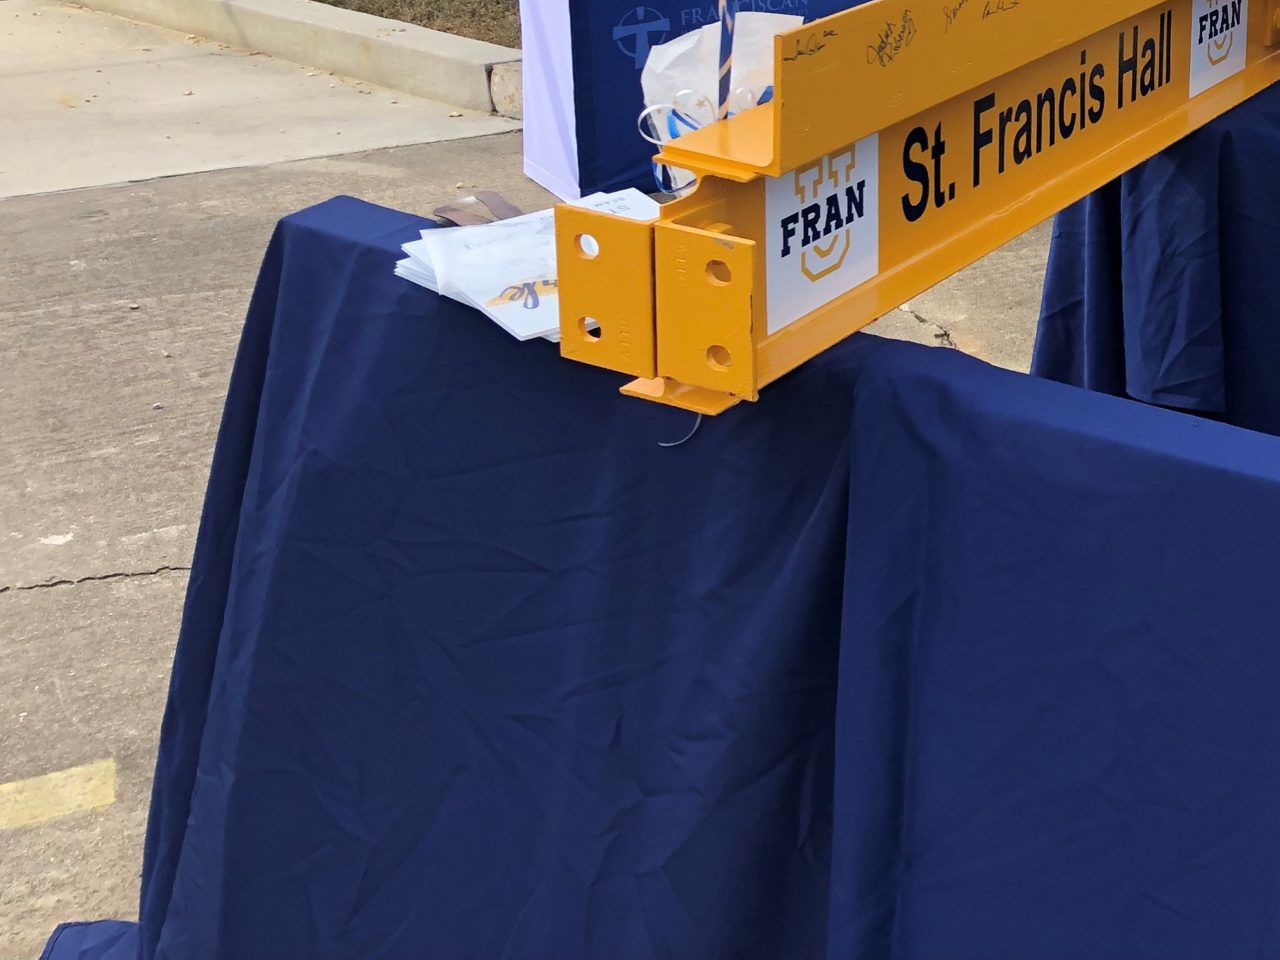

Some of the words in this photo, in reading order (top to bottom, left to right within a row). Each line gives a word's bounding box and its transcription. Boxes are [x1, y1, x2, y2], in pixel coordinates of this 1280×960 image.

[901, 120, 955, 223] St.
[972, 49, 1104, 188] Francis
[1117, 9, 1172, 109] Hall
[781, 179, 866, 258] FRAN
